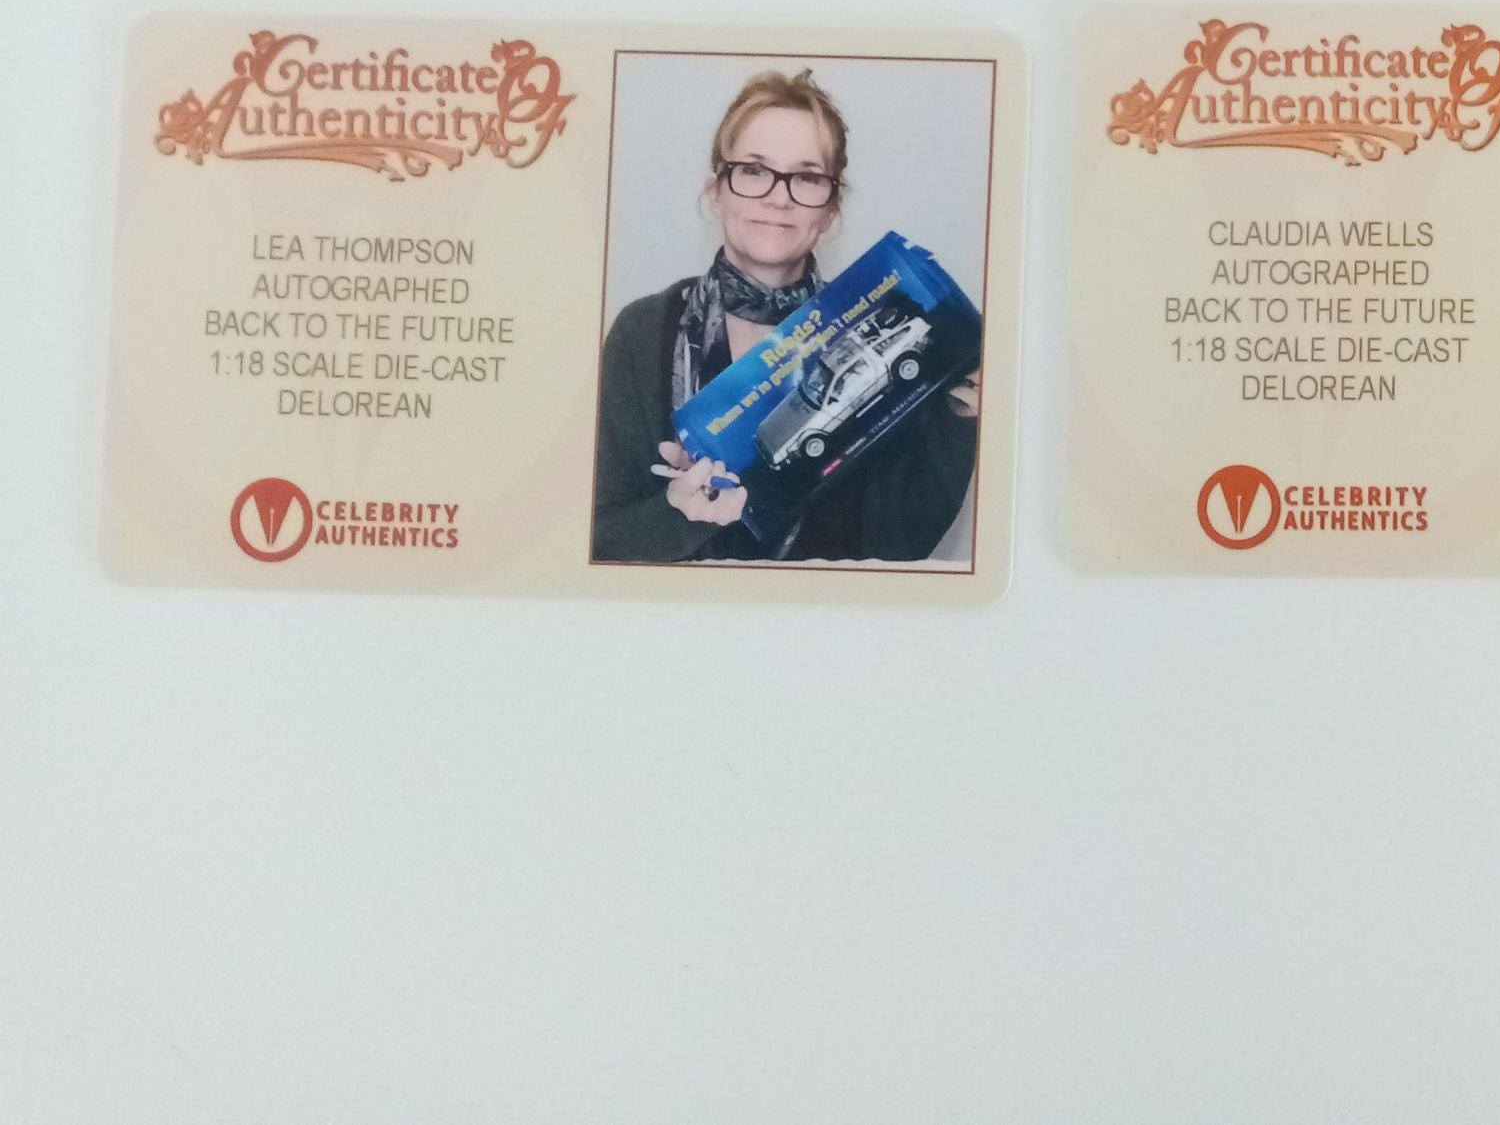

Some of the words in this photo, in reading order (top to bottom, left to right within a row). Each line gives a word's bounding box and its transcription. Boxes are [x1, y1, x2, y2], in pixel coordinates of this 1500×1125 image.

[234, 30, 499, 96] Certificate
[1184, 19, 1450, 84] Certificate
[200, 78, 492, 158] Authenticity
[1153, 66, 1445, 148] Authenticity
[252, 234, 305, 261] LEA
[313, 235, 474, 266] THOMPSON
[1207, 220, 1332, 247] CLAUDIA
[1339, 220, 1434, 248] WELLS
[251, 273, 470, 305] AUTOGRAPHED
[1211, 259, 1430, 287] AUTOGRAPHED
[1164, 296, 1242, 324] BACK
[1248, 297, 1289, 324] TO
[1296, 297, 1353, 324] THE
[1363, 297, 1476, 325] FUTURE
[204, 309, 281, 338] BACK
[288, 311, 328, 340] TO
[335, 313, 391, 341] THE
[401, 314, 515, 345] FUTURE
[760, 307, 822, 368] Roads?
[210, 349, 265, 377] 1:18
[272, 350, 364, 380] SCALE
[374, 353, 507, 383] DIE-CAST
[707, 402, 747, 436] Where
[841, 296, 872, 324] need
[1171, 336, 1227, 363] 1:18
[1234, 336, 1327, 363] SCALE
[1337, 336, 1470, 364] DIE-CAST
[277, 388, 432, 420] DELOREAN
[1241, 374, 1397, 402] DELOREAN
[315, 499, 460, 525] CELEBRITY
[1283, 485, 1428, 508] CELEBRITY
[313, 523, 460, 550] AUTHENTICS
[1282, 509, 1429, 532] AUTHENTICS
